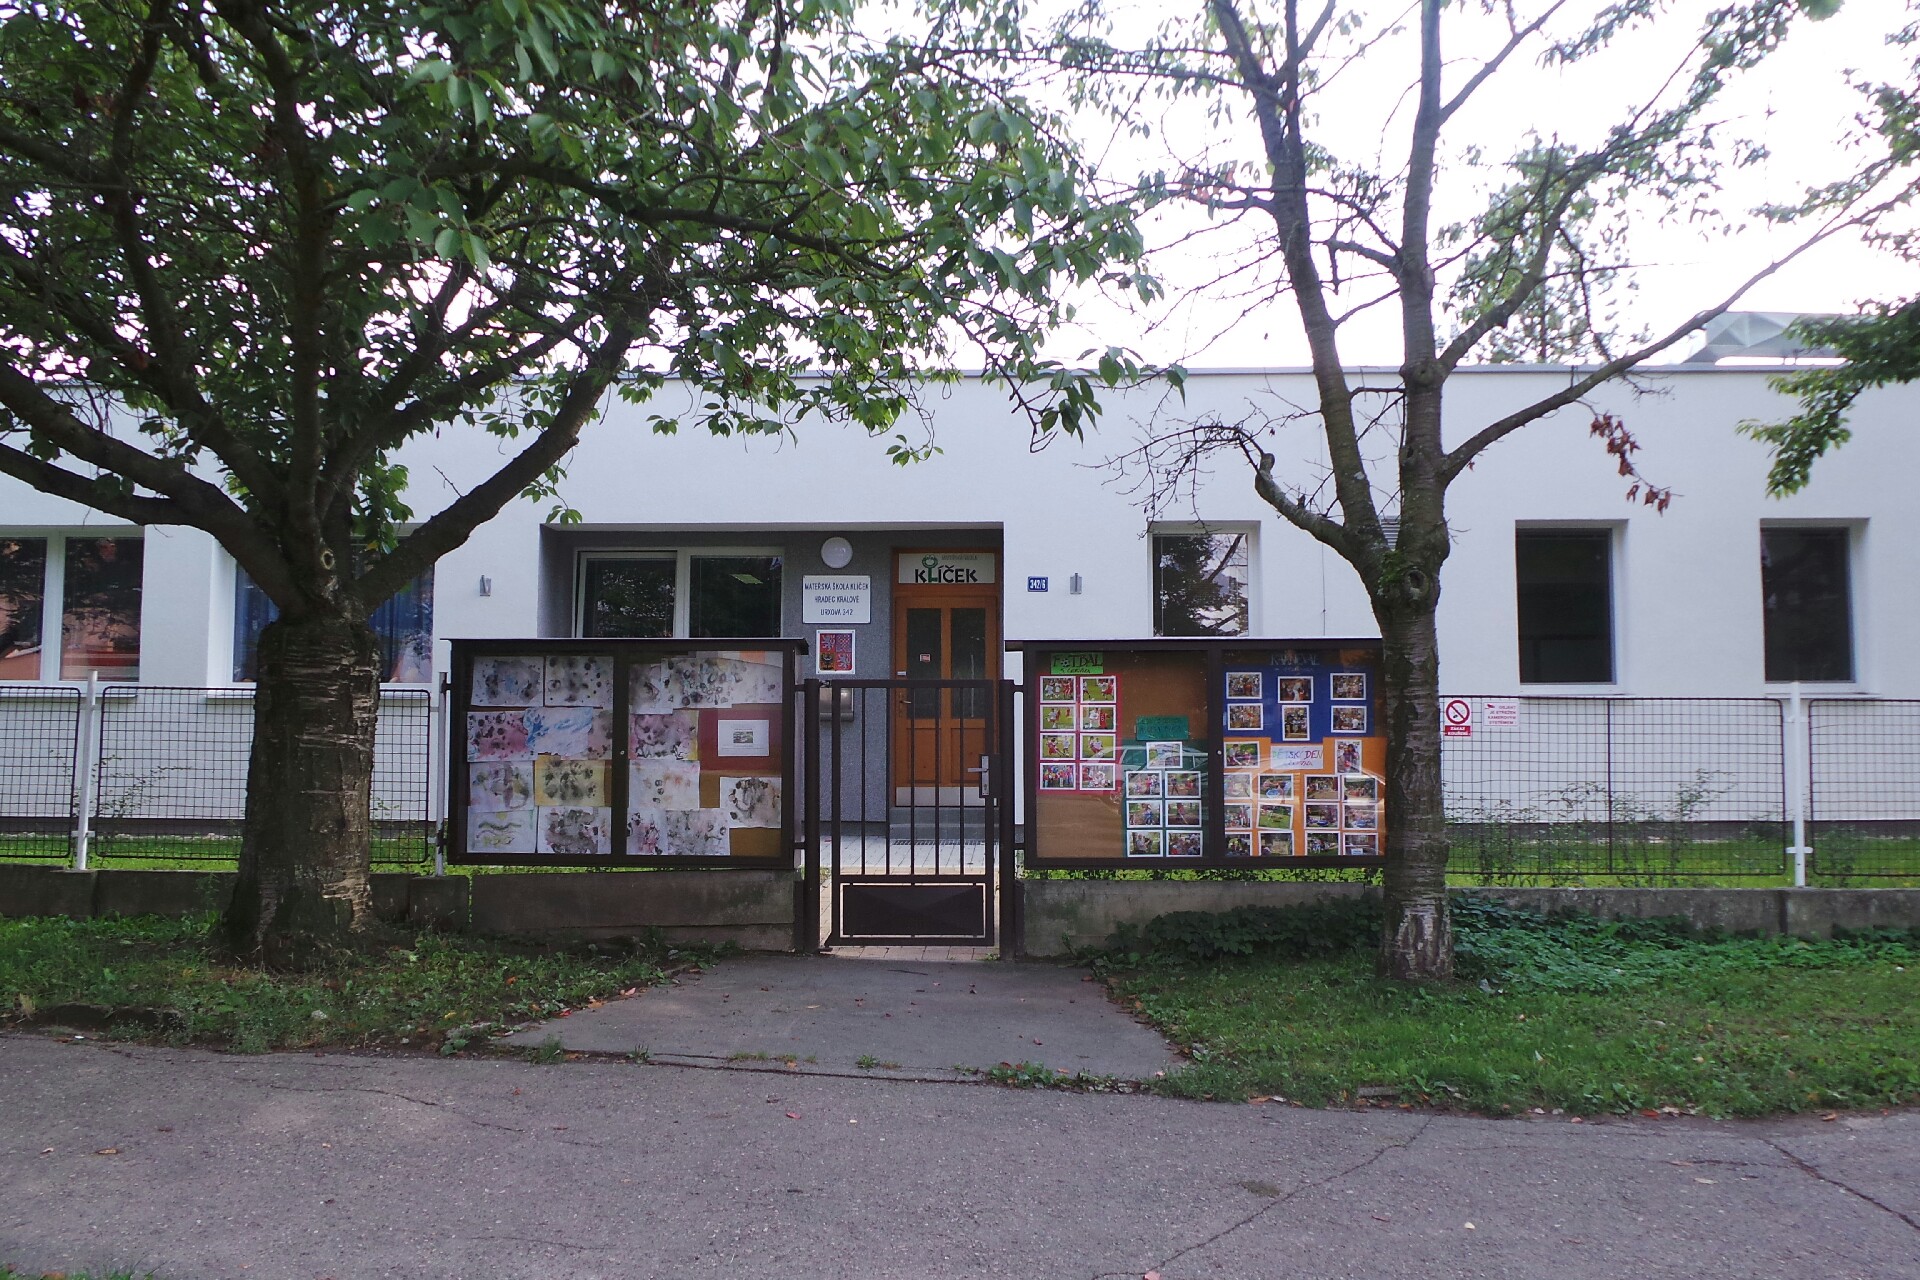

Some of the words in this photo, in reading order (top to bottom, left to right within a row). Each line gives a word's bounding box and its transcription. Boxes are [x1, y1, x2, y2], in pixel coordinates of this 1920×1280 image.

[915, 564, 978, 583] KLÍČEK
[832, 582, 850, 591] ŠKOLA
[814, 595, 836, 603] HRADEC
[1304, 750, 1323, 760] DEN
